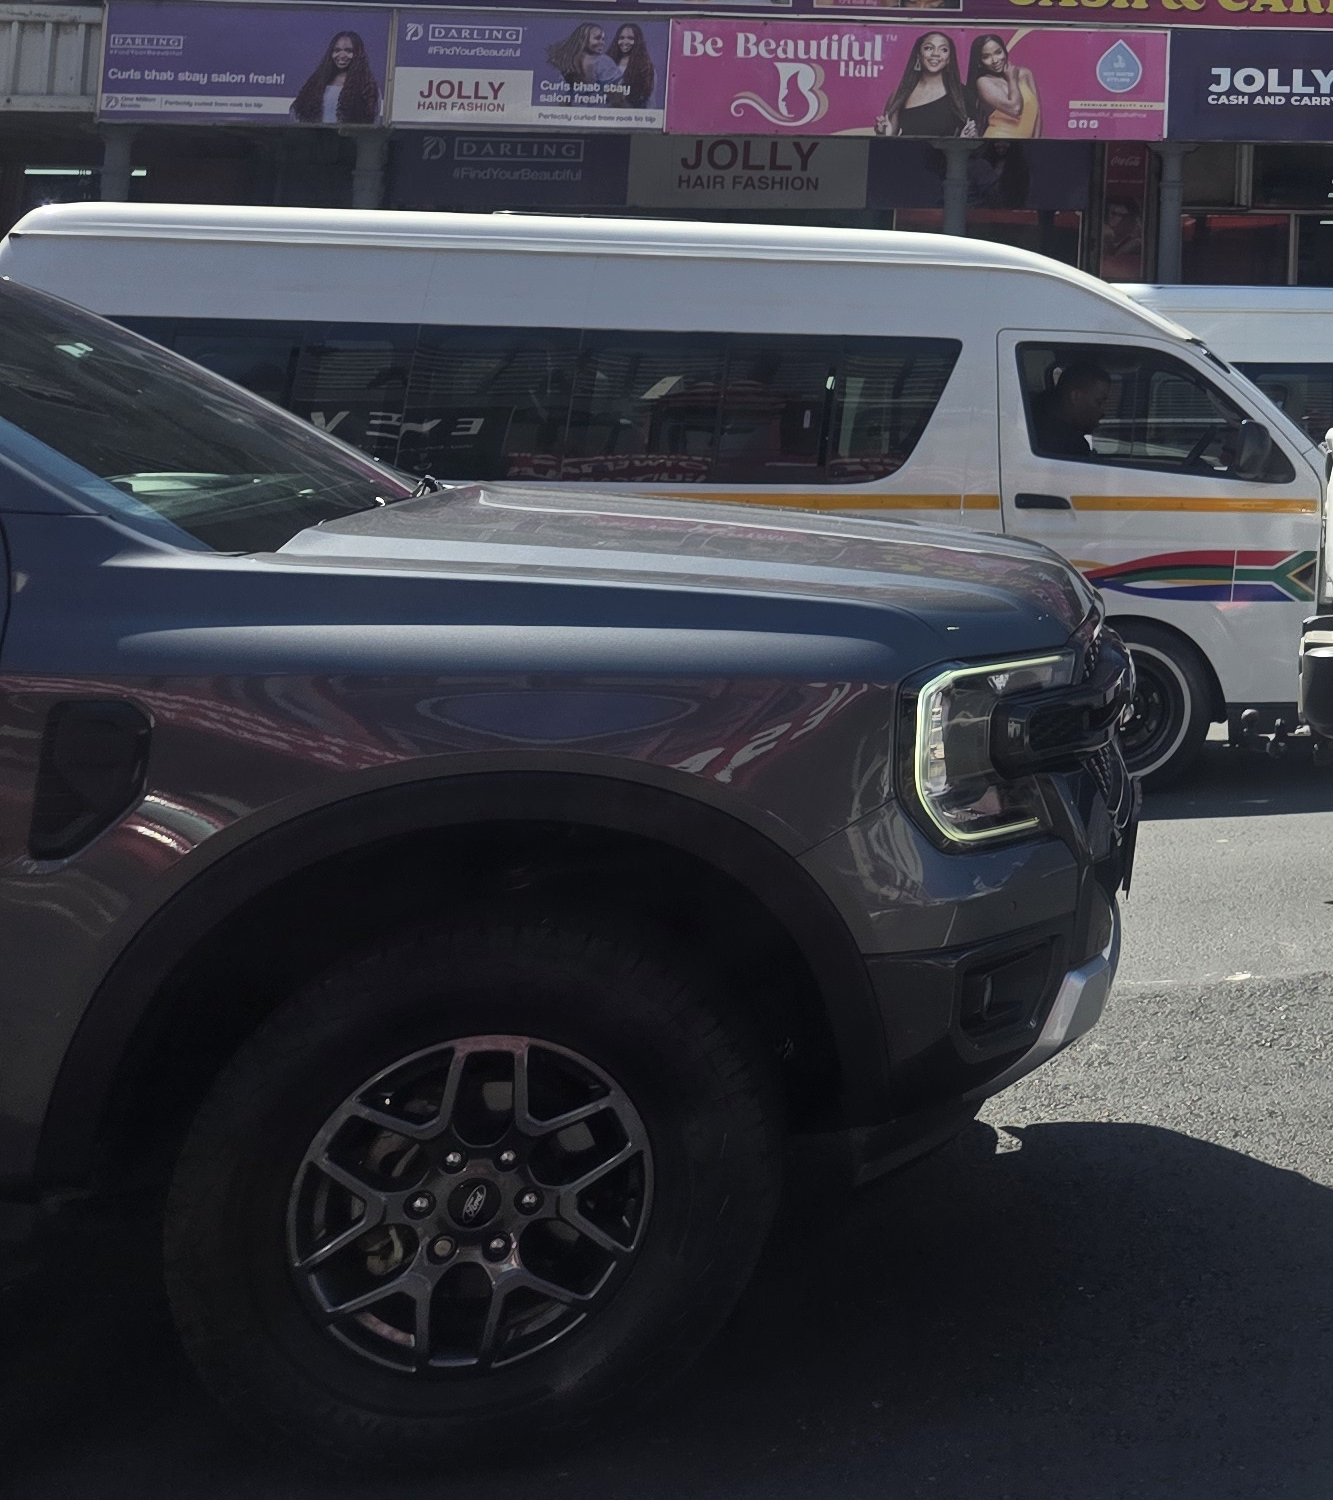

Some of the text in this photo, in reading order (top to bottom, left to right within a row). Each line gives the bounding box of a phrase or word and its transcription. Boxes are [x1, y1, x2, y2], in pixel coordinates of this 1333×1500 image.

[435, 28, 517, 40] DARLING
[428, 46, 521, 57] #FindYourBeautiful
[683, 31, 723, 57] Be
[736, 32, 883, 61] Beautiful
[108, 68, 285, 84] Curls that stay salon fresh!
[839, 61, 884, 78] Hair
[419, 80, 505, 100] JOLLY
[540, 80, 631, 96] Curls that stay
[417, 101, 505, 112] HAIR FASHION
[540, 93, 607, 104] salon fresh!
[1208, 95, 1249, 105] CASH
[1253, 96, 1286, 105] AND
[463, 141, 577, 158] DARLING
[680, 138, 820, 172] JOLLY
[453, 166, 582, 182] #FindYourBeautiful
[678, 174, 820, 192] HAIR FASHION
